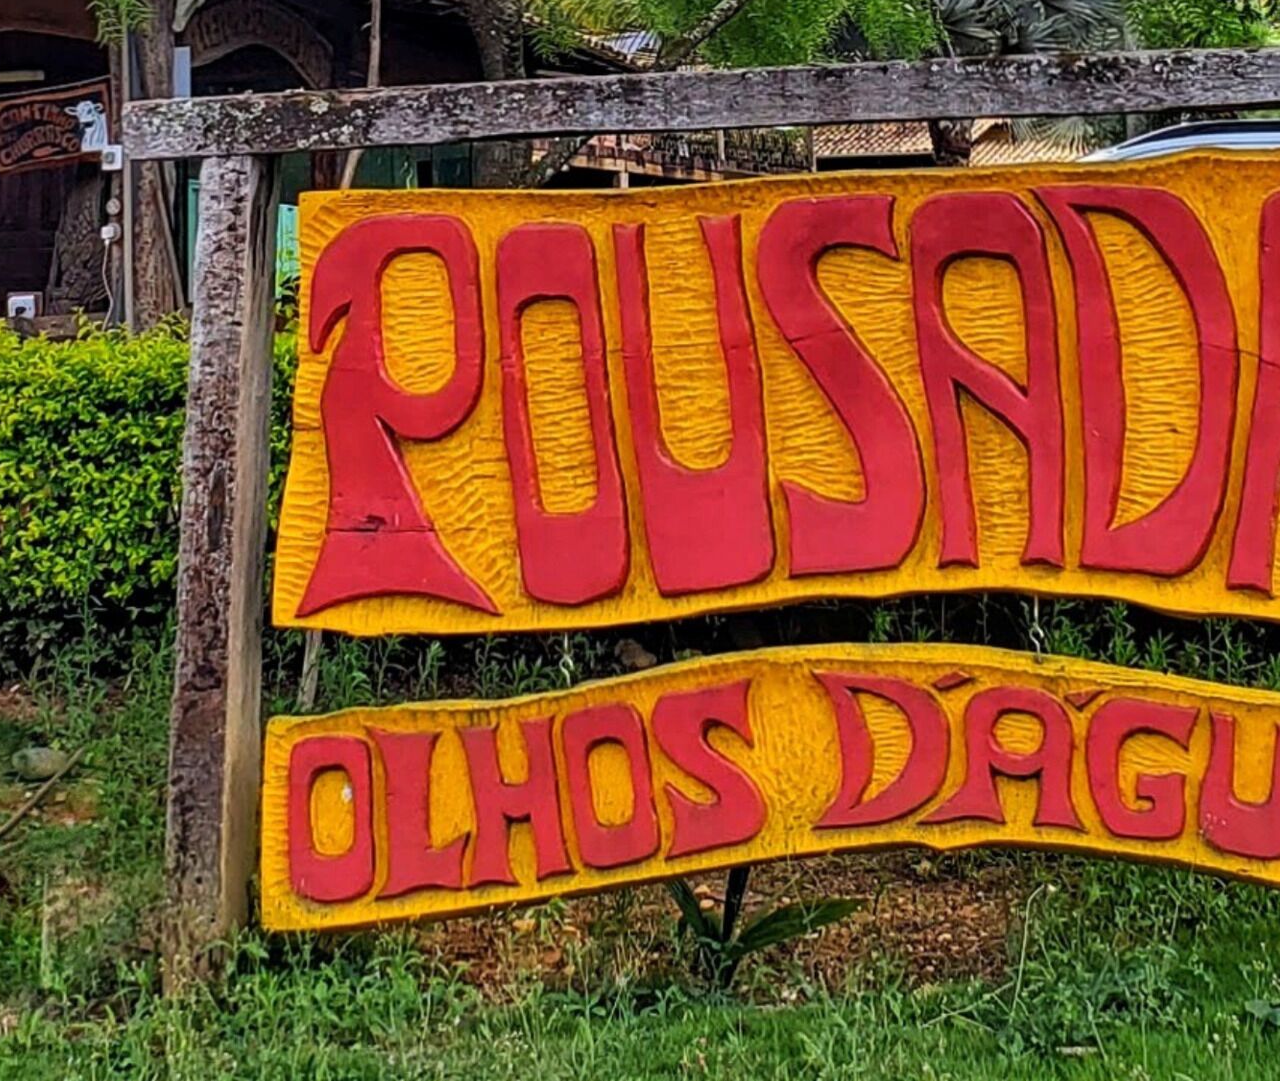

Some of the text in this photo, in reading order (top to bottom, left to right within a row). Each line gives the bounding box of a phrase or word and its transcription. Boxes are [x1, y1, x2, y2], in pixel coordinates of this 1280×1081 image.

[0, 103, 76, 130] CANTINHO
[0, 125, 80, 165] CHURRASCO
[287, 677, 767, 904] OLHOS
